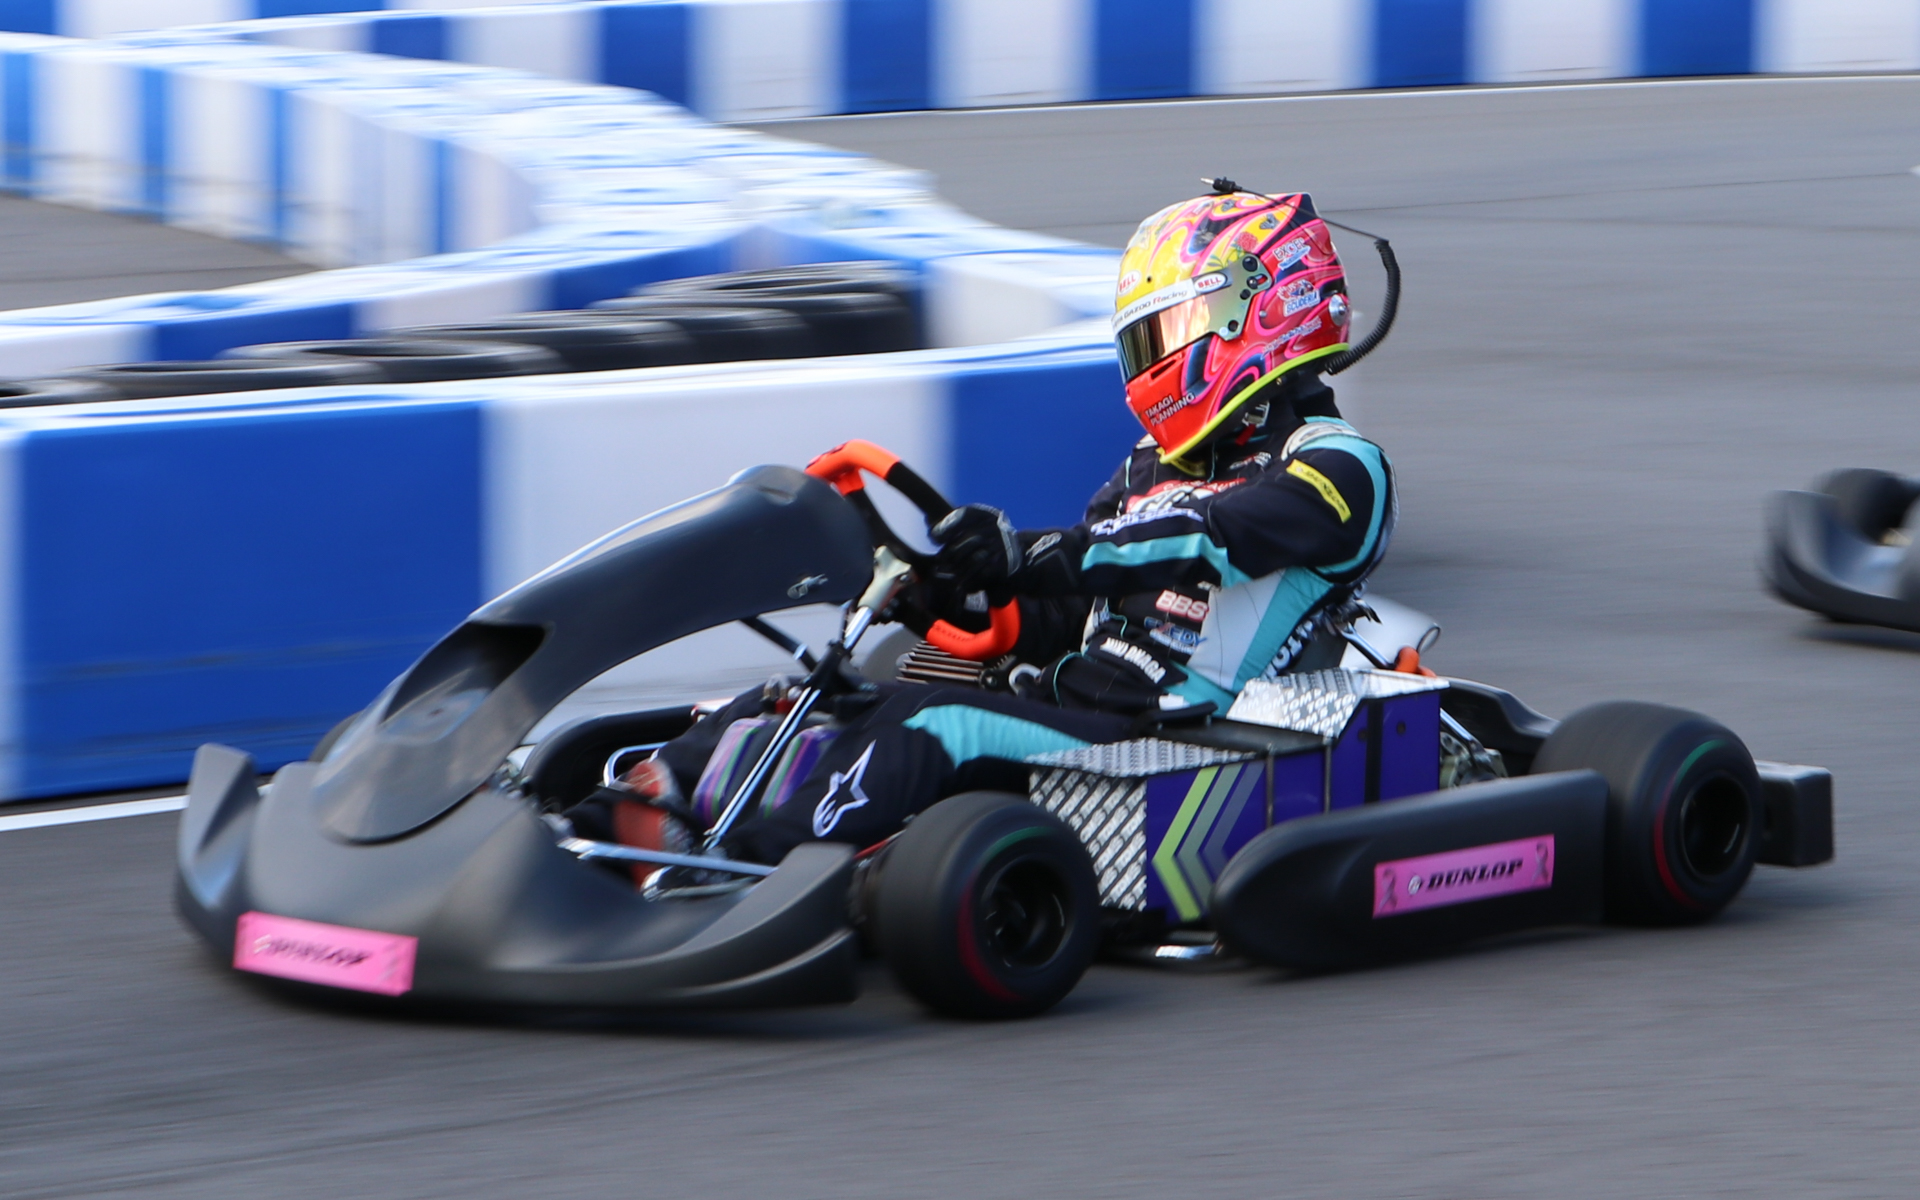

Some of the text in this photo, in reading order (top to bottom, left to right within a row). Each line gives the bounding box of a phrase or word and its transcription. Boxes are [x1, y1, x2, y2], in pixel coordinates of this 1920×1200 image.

[1198, 276, 1221, 289] BELL
[1123, 289, 1188, 318] GAZOO Racing
[1145, 395, 1174, 418] TAKAGI
[1150, 392, 1195, 427] PLANNING
[1156, 589, 1209, 622] BBS
[1427, 858, 1524, 891] DUNLOP
